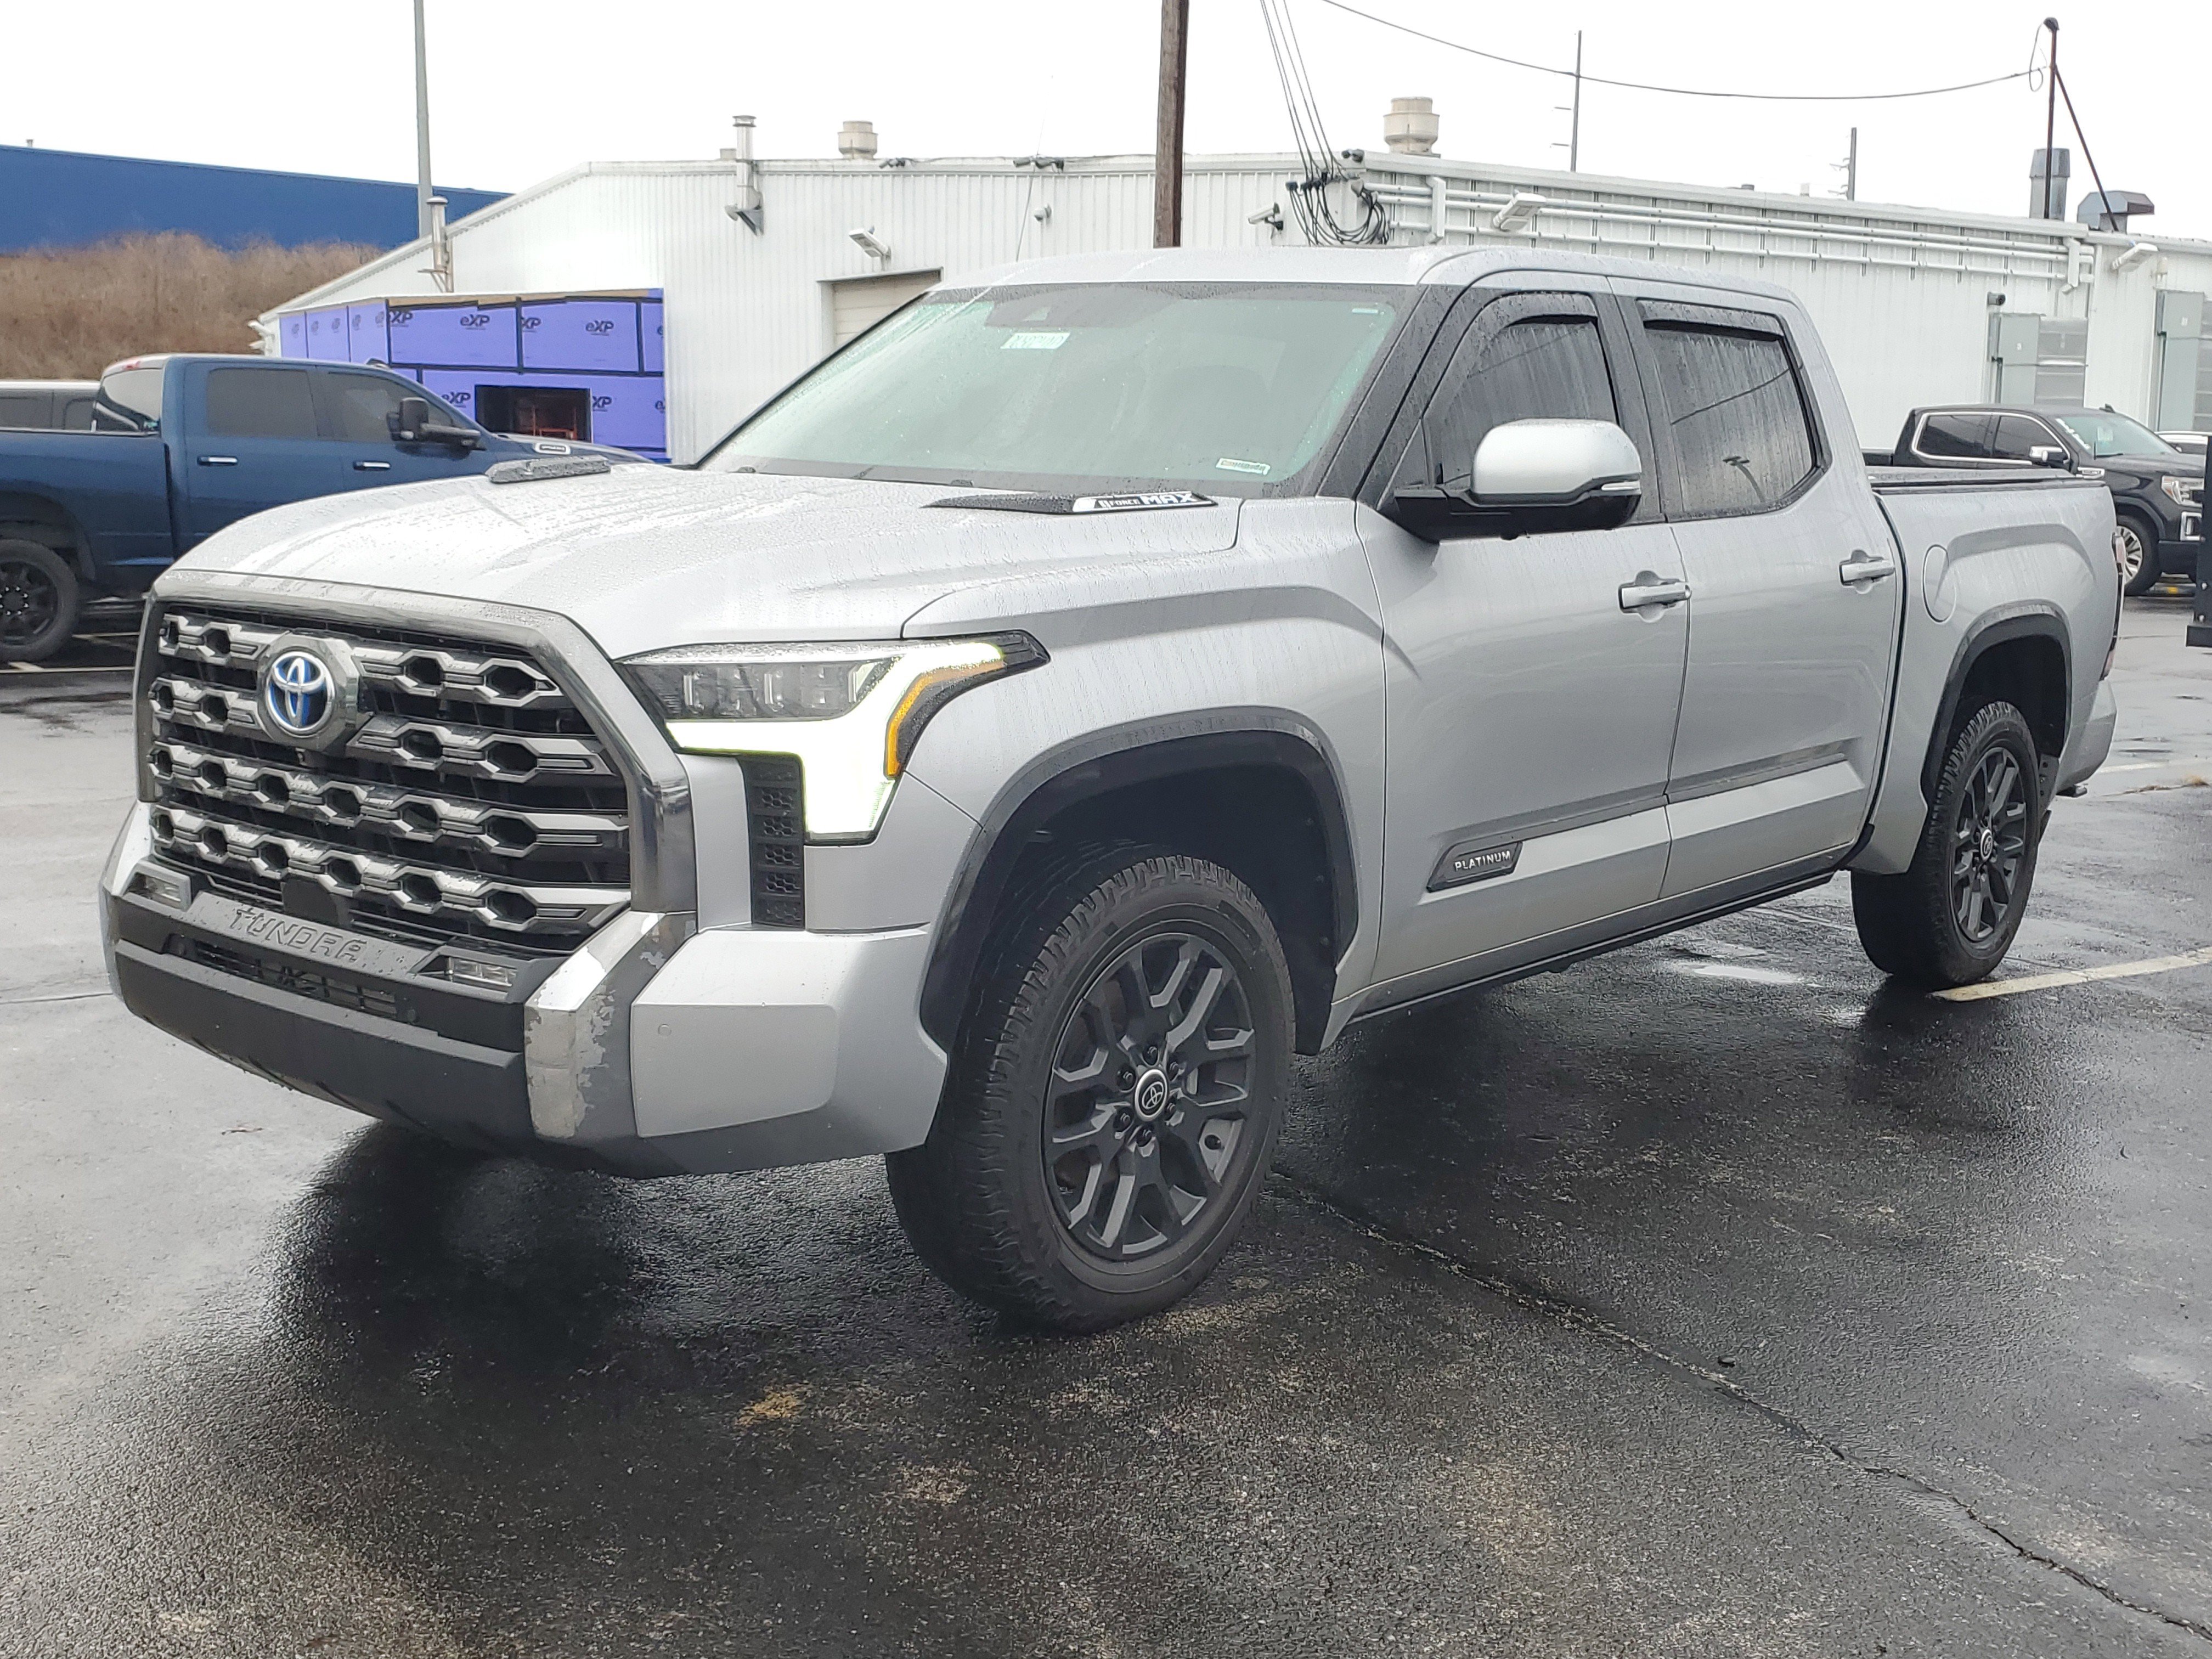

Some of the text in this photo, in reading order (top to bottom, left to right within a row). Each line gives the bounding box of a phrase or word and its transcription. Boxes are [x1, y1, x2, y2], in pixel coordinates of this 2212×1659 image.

[387, 311, 413, 324] XP
[521, 317, 541, 329] XP
[592, 396, 612, 408] XP
[1141, 493, 1197, 505] MAX
[1454, 850, 1510, 871] PLATINUM
[229, 907, 368, 962] TUNDRA
